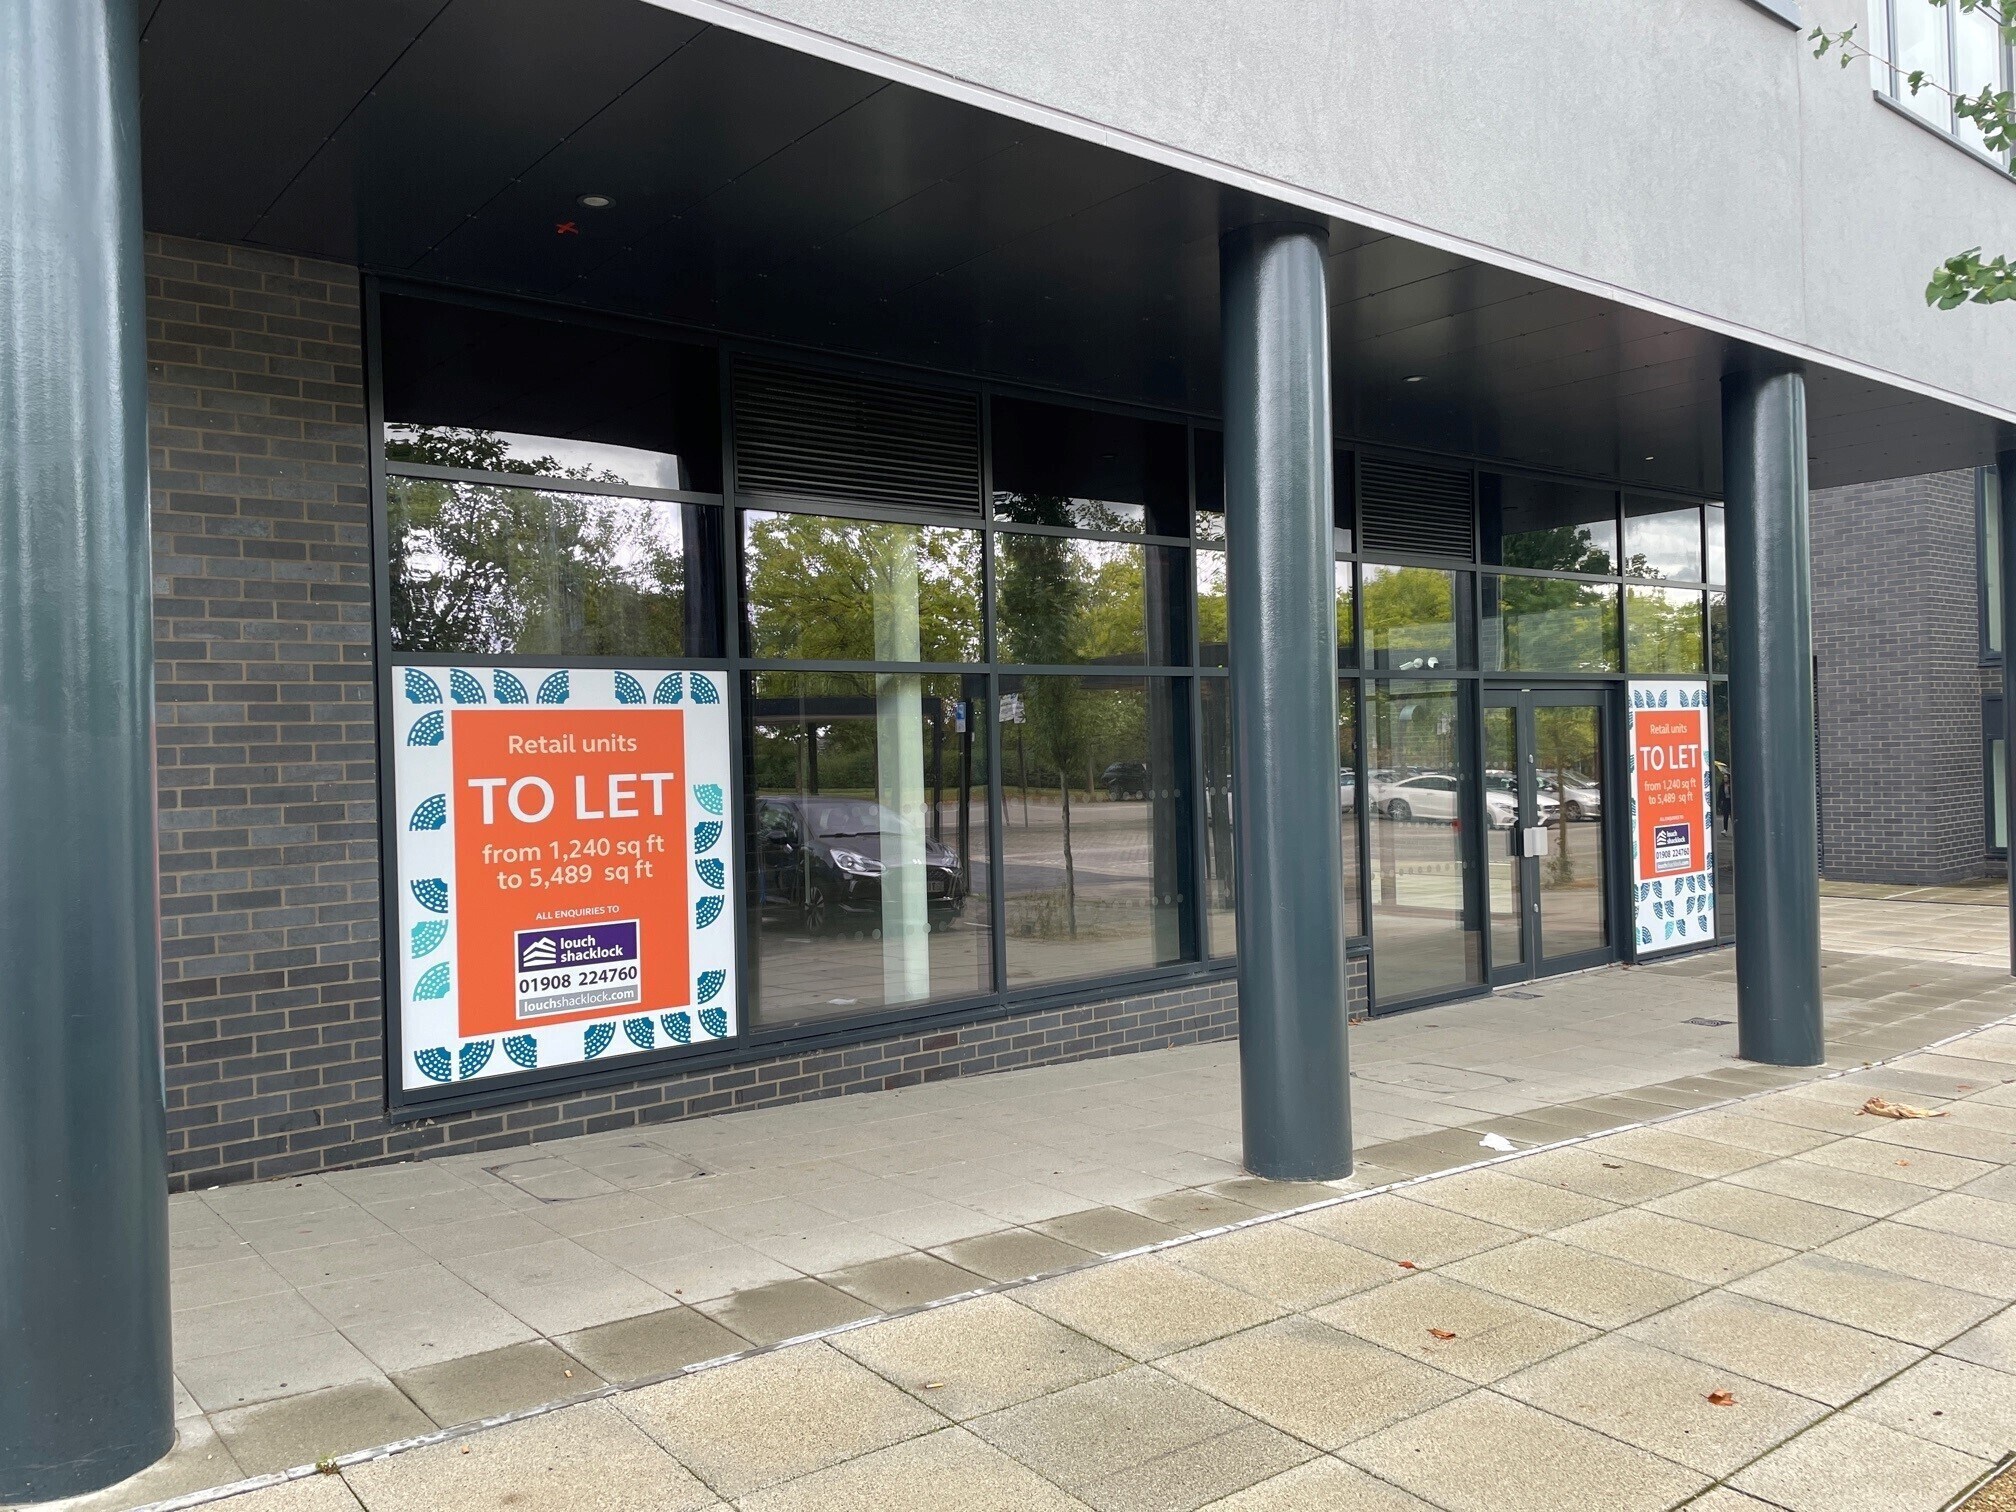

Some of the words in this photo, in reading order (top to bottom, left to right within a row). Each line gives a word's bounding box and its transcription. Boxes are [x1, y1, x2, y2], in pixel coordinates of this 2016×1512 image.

[1650, 723, 1670, 735] Retail
[1671, 722, 1688, 734] units
[508, 733, 576, 754] Retail
[582, 733, 638, 753] units
[1639, 745, 1665, 771] TO
[1669, 744, 1699, 770] LET
[1644, 780, 1661, 792] from
[1663, 778, 1680, 792] 1,240
[1681, 779, 1690, 790] sq
[1690, 777, 1697, 788] ft
[468, 776, 555, 825] TO
[575, 772, 674, 820] LET
[1648, 795, 1656, 805] to
[1657, 792, 1676, 805] 5,489
[1679, 793, 1687, 804] sq
[1687, 791, 1693, 801] ft
[482, 844, 541, 865] from
[549, 837, 610, 862] 1,240
[616, 839, 641, 858] sq
[646, 834, 665, 853] ft
[496, 871, 523, 890] to
[529, 864, 592, 890] 5,489
[604, 865, 629, 885] sq
[635, 859, 653, 879] ft
[536, 912, 553, 921] ALL
[554, 906, 605, 919] ENQUIRIES
[607, 905, 620, 914] TO
[560, 934, 596, 950] louch
[560, 944, 624, 963] shacklock
[519, 974, 571, 994] 01908
[578, 966, 638, 987] 224760
[524, 988, 635, 1012] louchshacklock.com
